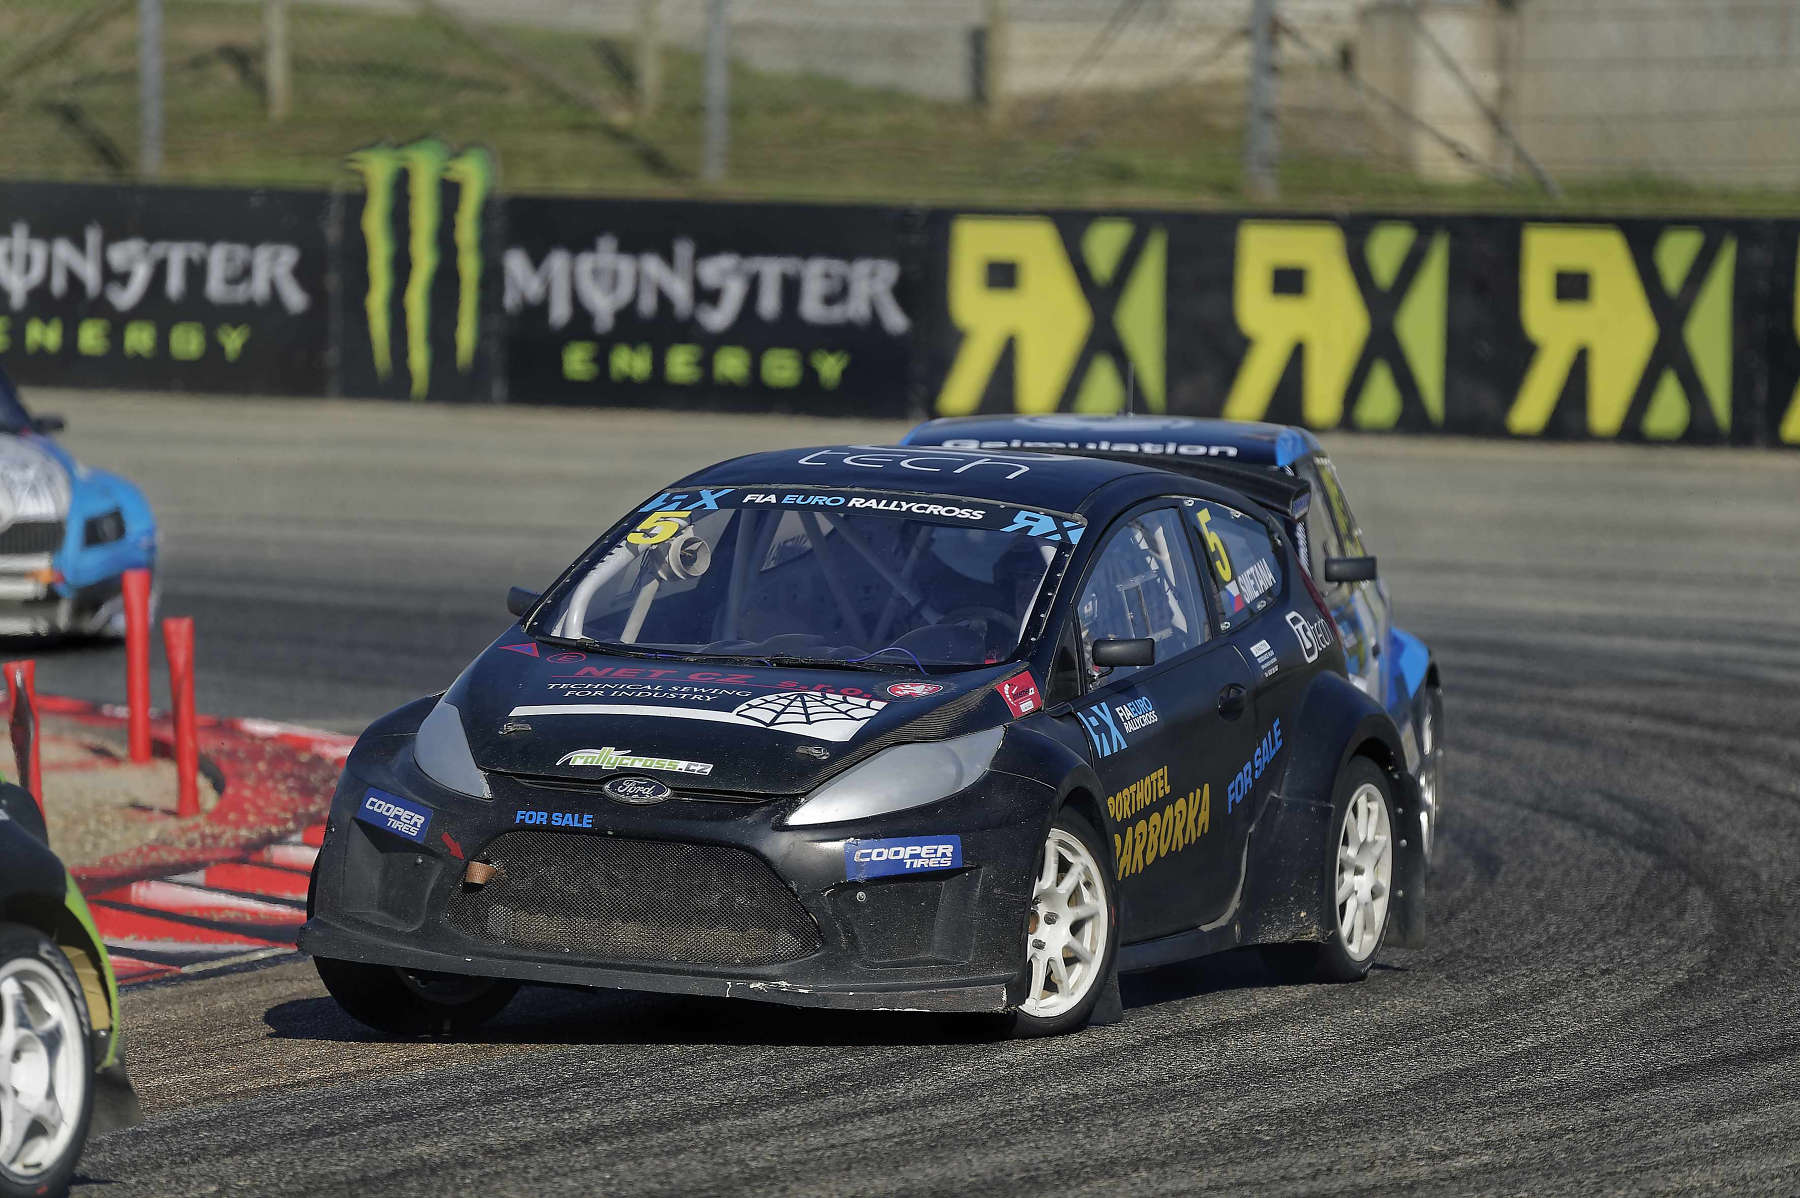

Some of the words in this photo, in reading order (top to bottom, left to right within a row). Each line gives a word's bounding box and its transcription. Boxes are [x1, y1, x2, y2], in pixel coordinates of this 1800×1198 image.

[503, 234, 911, 335] MONSTER
[561, 341, 850, 389] ENERGY
[742, 493, 777, 504] FIA
[781, 494, 845, 507] EURO
[847, 497, 987, 520] RALLYCROSS
[627, 511, 692, 544] 5
[1196, 508, 1231, 582] 5
[688, 672, 756, 684] CZ
[547, 683, 663, 691] TECHNICAL
[668, 686, 752, 697] SEWING
[609, 691, 718, 702] INDUSTRY
[1123, 710, 1158, 733] RALLYCROSS
[569, 747, 712, 775] rallycross.cz
[1227, 761, 1253, 814] FOR
[1254, 717, 1283, 779] SALE
[617, 779, 656, 796] Ford
[365, 796, 425, 828] COOPER
[515, 810, 547, 825] FOR
[551, 812, 593, 828] SALE
[387, 817, 419, 837] TIRES
[854, 844, 954, 862] COOPER
[903, 857, 953, 869] TIRES
